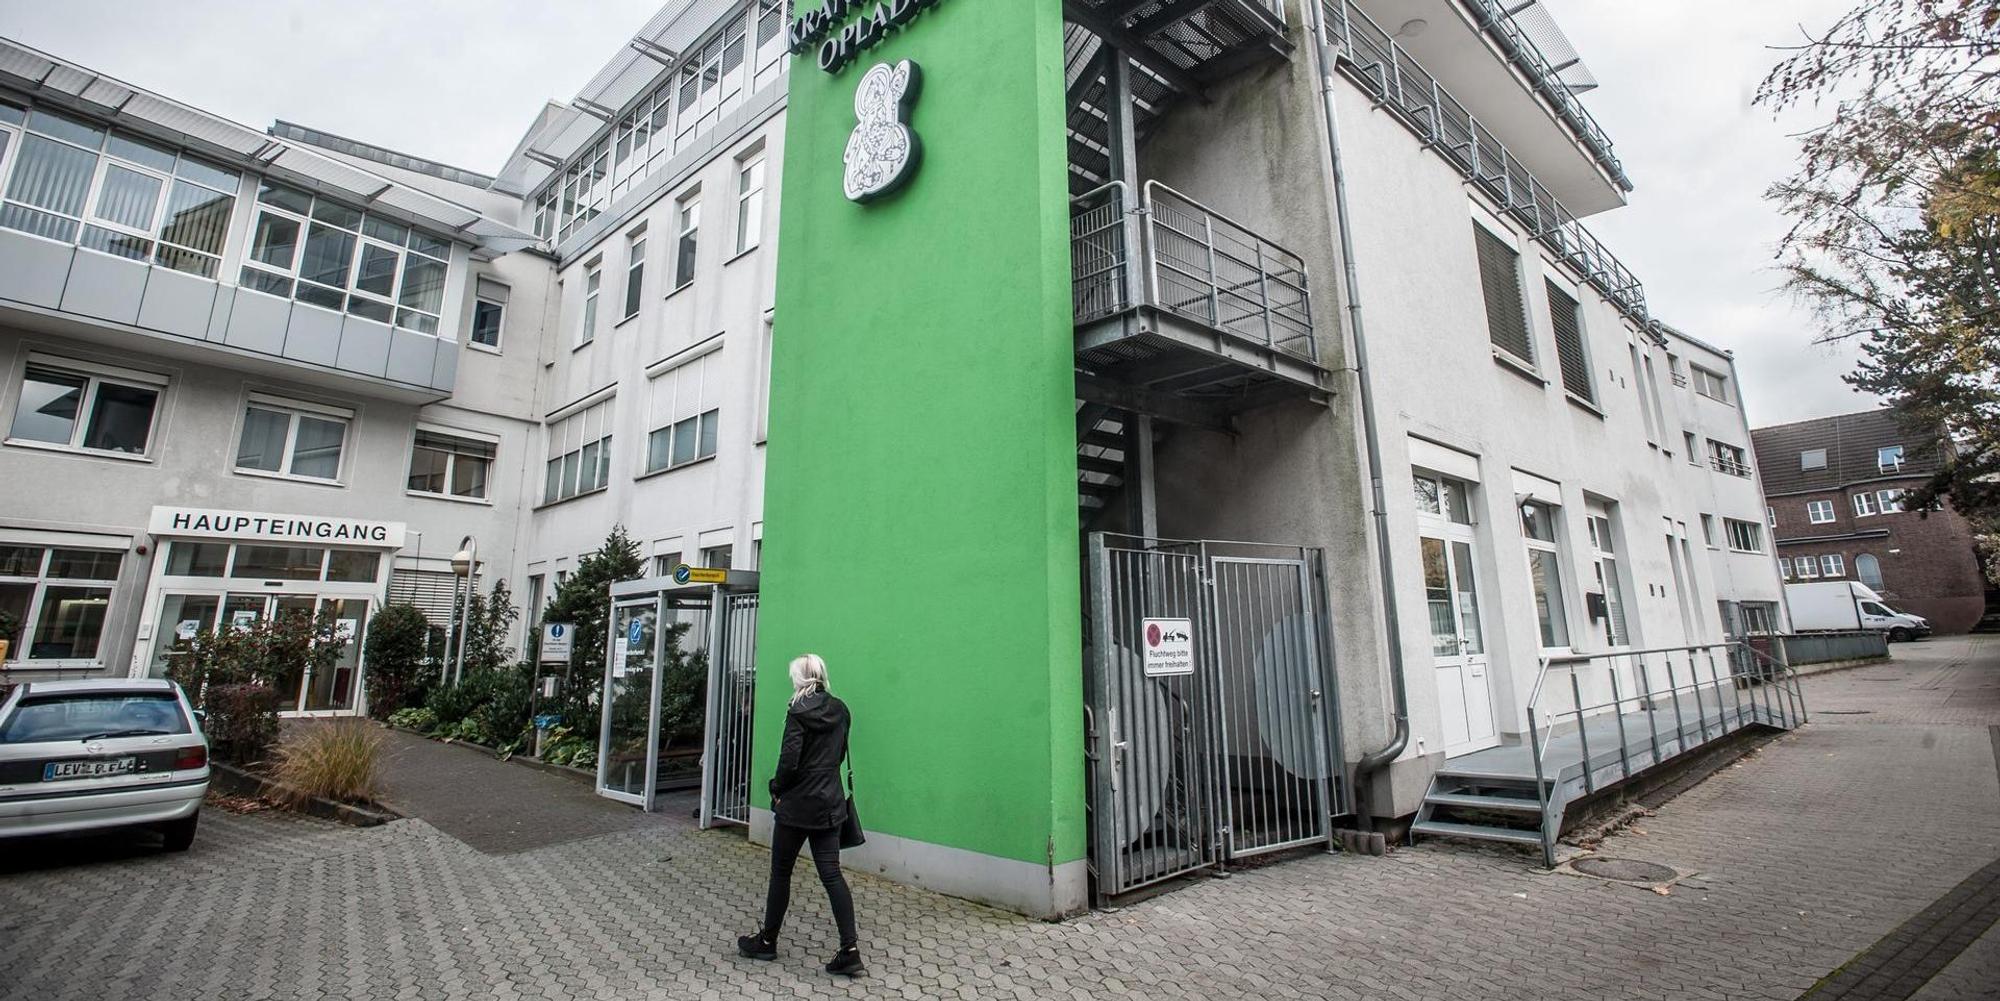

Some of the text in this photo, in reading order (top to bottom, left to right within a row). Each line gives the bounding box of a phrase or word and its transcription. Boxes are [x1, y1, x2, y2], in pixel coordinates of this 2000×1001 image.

[817, 0, 920, 72] OPLAD
[173, 513, 387, 541] HAUPTEINGANG
[1149, 650, 1176, 658] Fluchtweg
